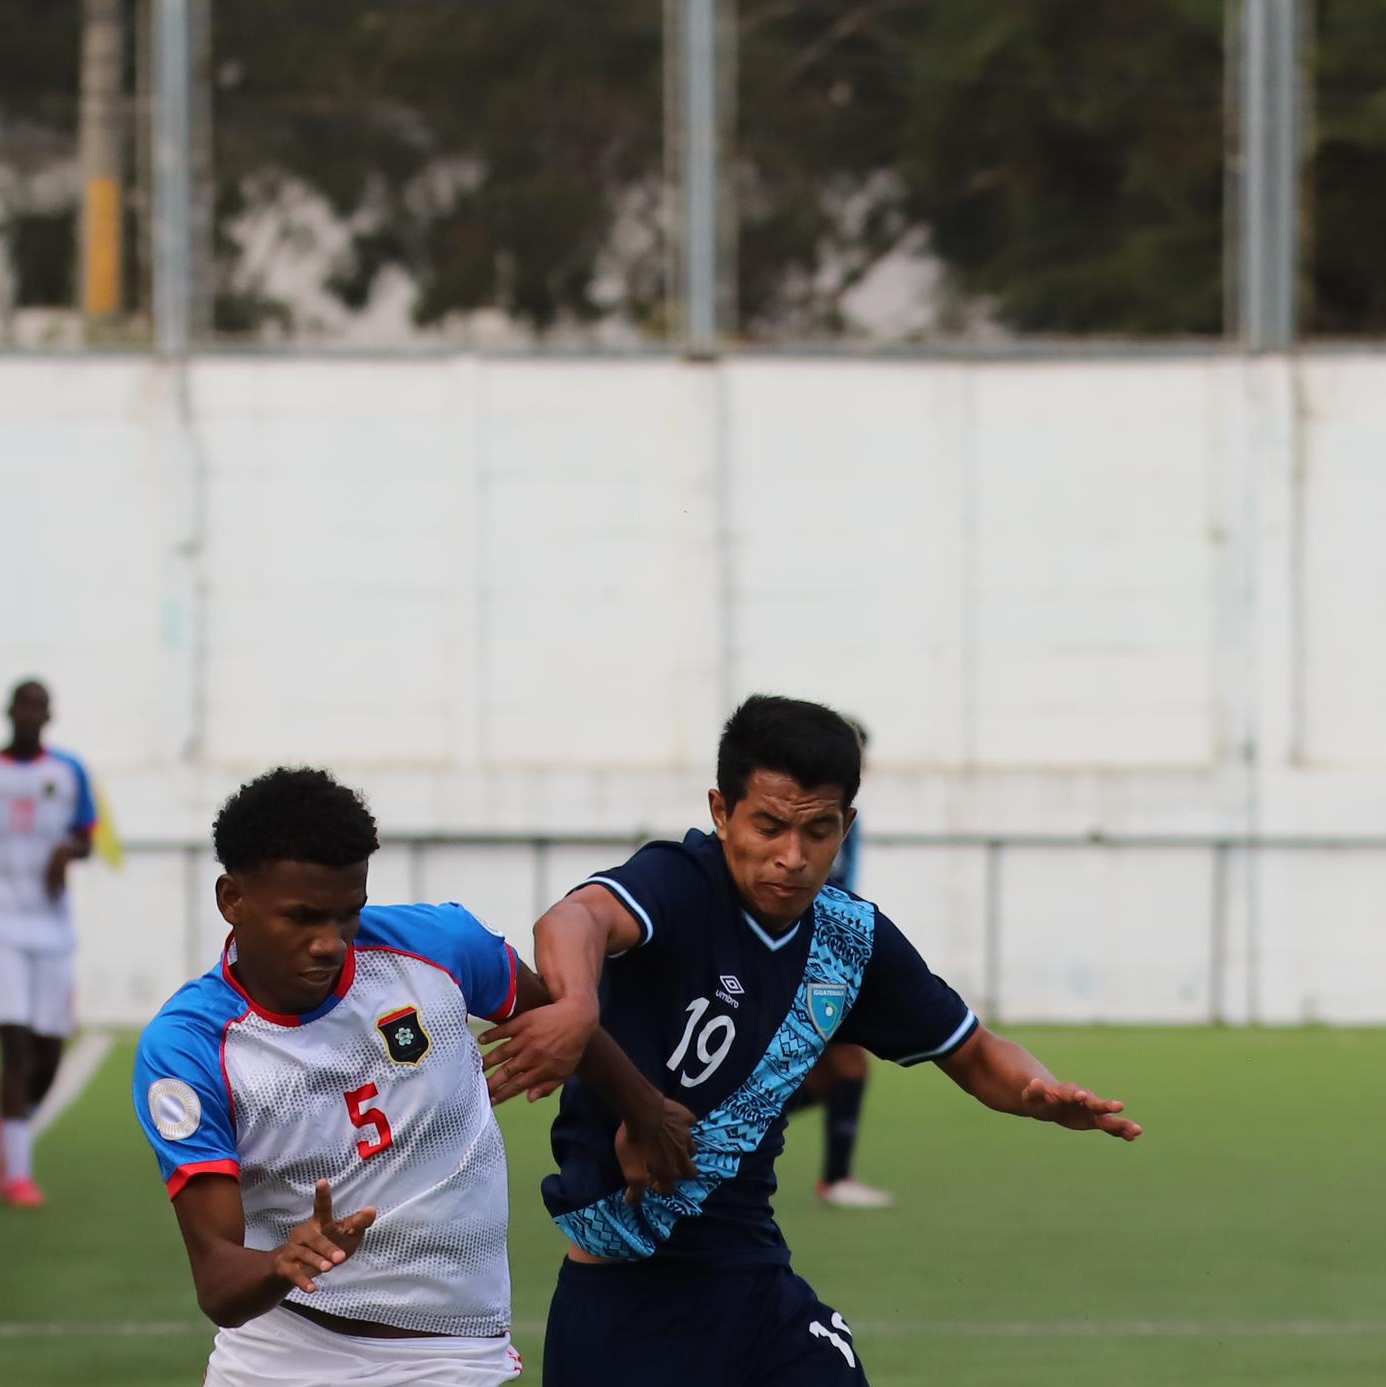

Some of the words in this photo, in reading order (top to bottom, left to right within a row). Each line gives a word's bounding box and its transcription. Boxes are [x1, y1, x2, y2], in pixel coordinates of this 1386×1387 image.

[715, 989, 739, 1009] umbro
[666, 997, 736, 1088] 19
[343, 1082, 393, 1160] 5
